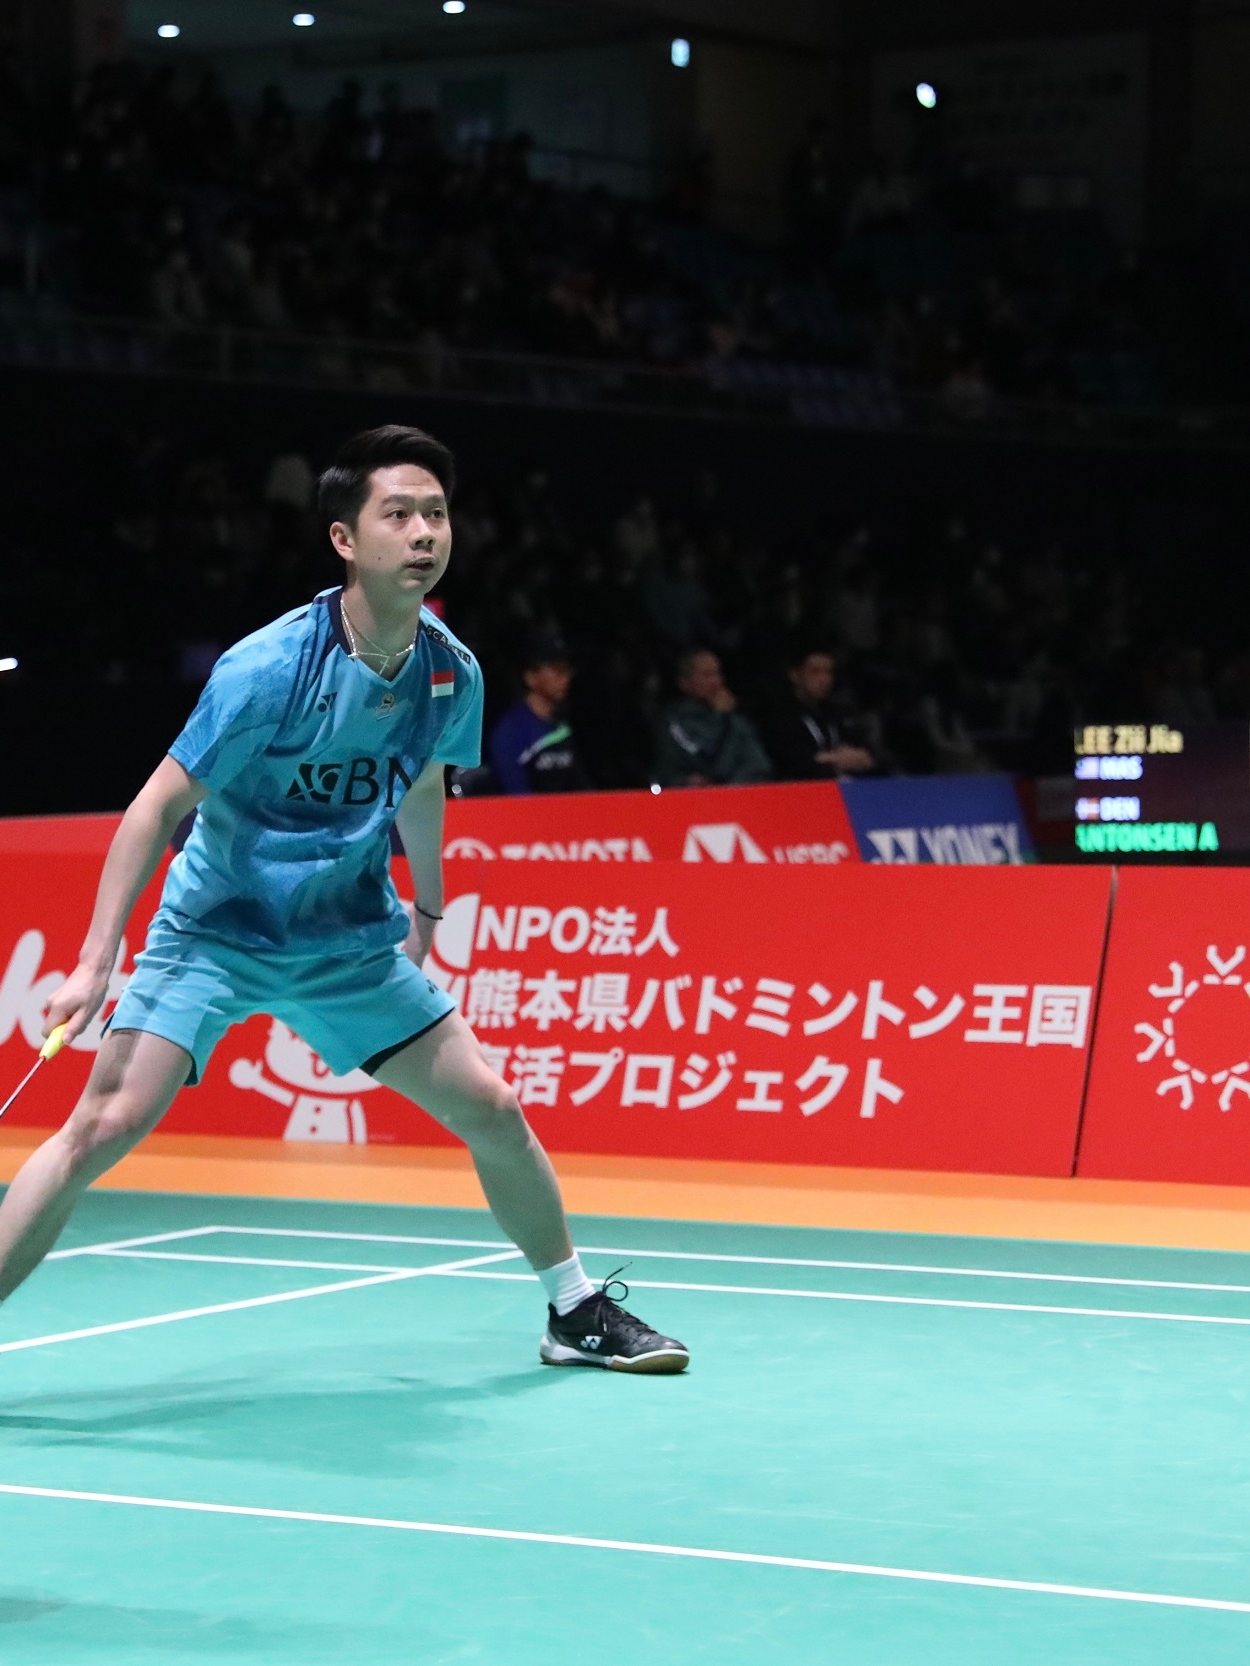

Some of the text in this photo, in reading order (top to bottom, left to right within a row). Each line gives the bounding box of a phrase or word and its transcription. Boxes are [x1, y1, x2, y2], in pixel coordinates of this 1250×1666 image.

[1100, 755, 1143, 780] MAS
[1100, 796, 1141, 821] DEN
[1198, 821, 1220, 851] A
[475, 905, 680, 957] NPO法人
[466, 968, 1093, 1049] 熊本県バドミントン王国
